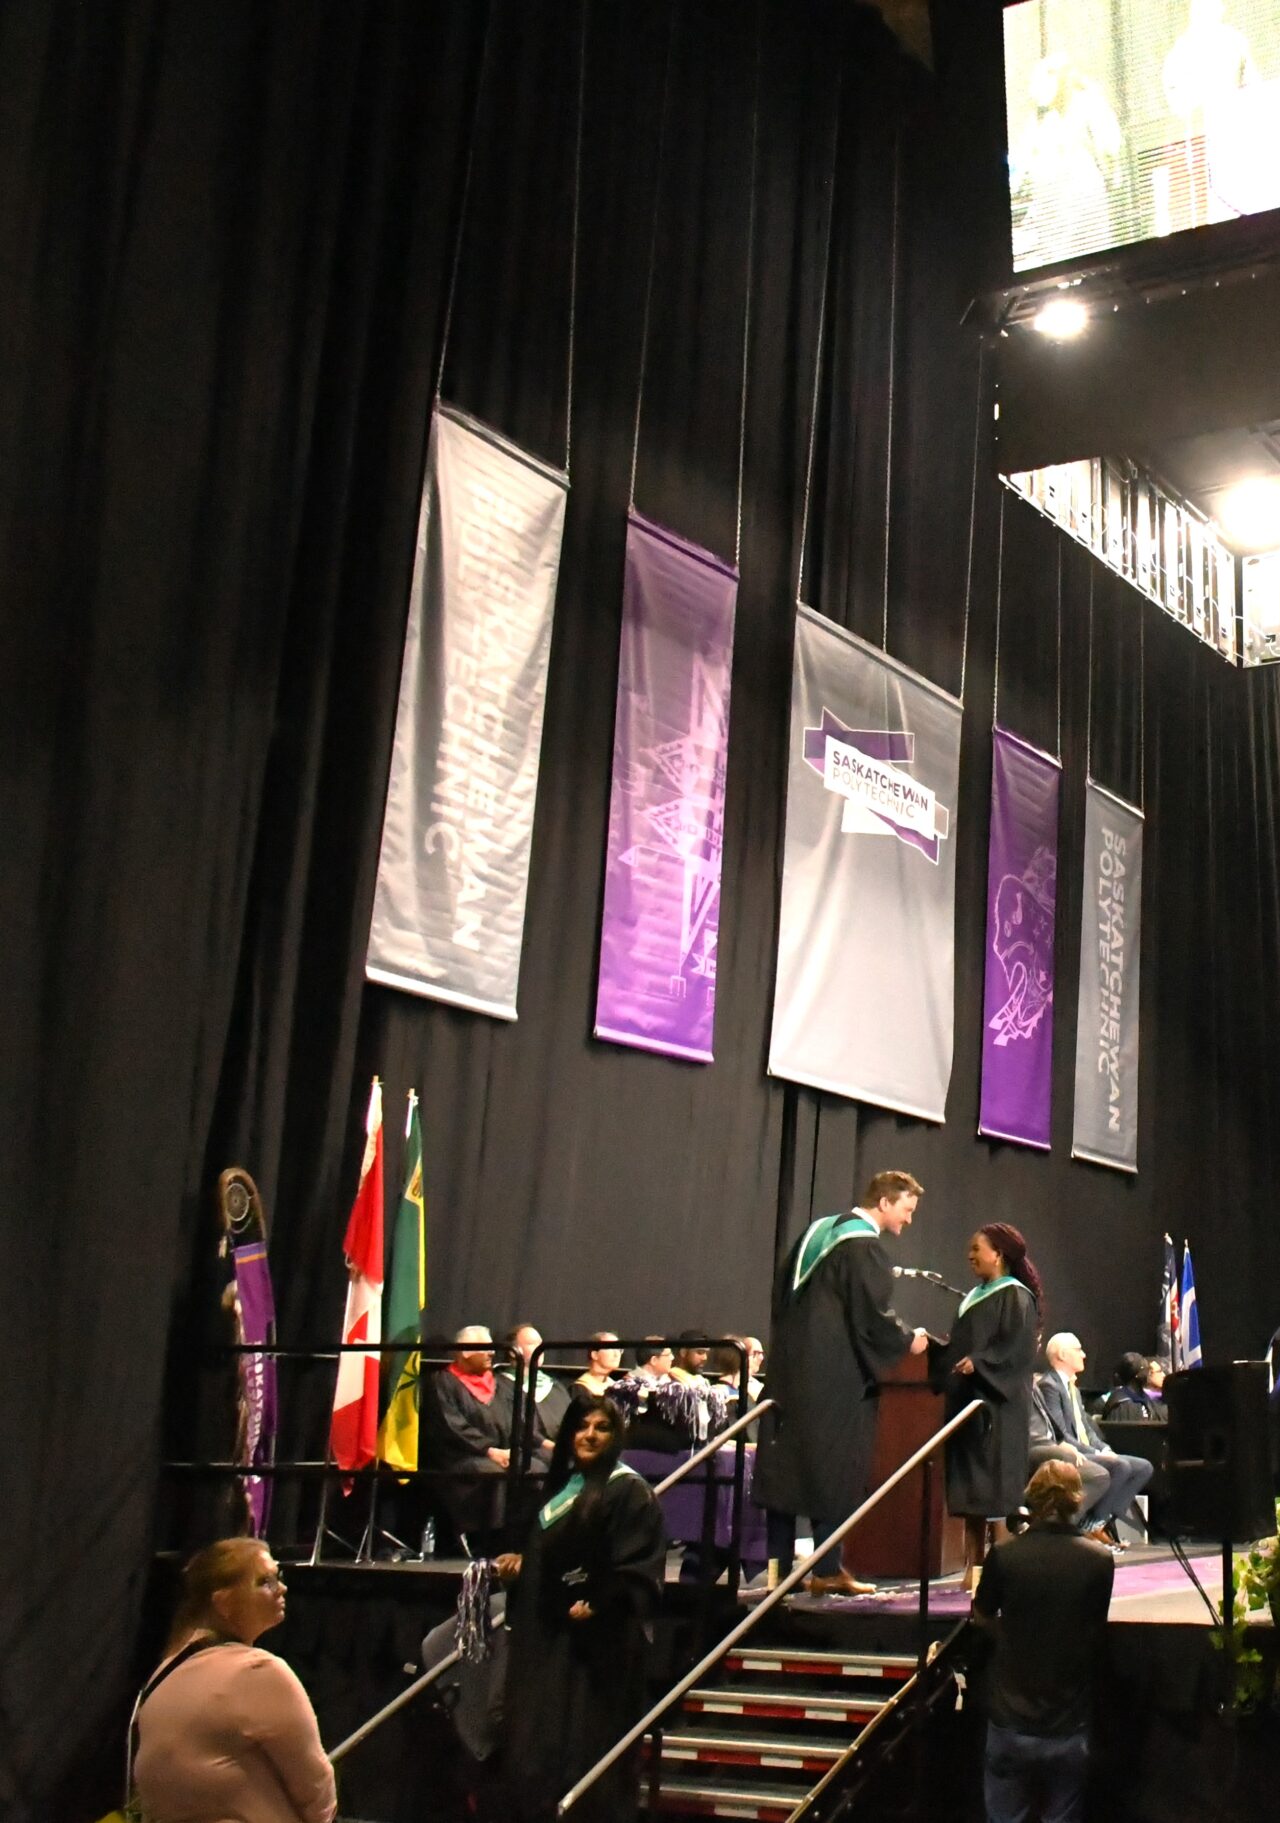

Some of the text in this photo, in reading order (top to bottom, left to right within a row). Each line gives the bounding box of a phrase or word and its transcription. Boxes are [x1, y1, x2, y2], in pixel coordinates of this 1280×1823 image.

[832, 767, 916, 819] POLYTECHNIC
[833, 750, 929, 812] SASKATCHEWAN
[1098, 827, 1114, 1075] POLYTECHNIC
[1108, 834, 1127, 1133] SASKATCHEWAN
